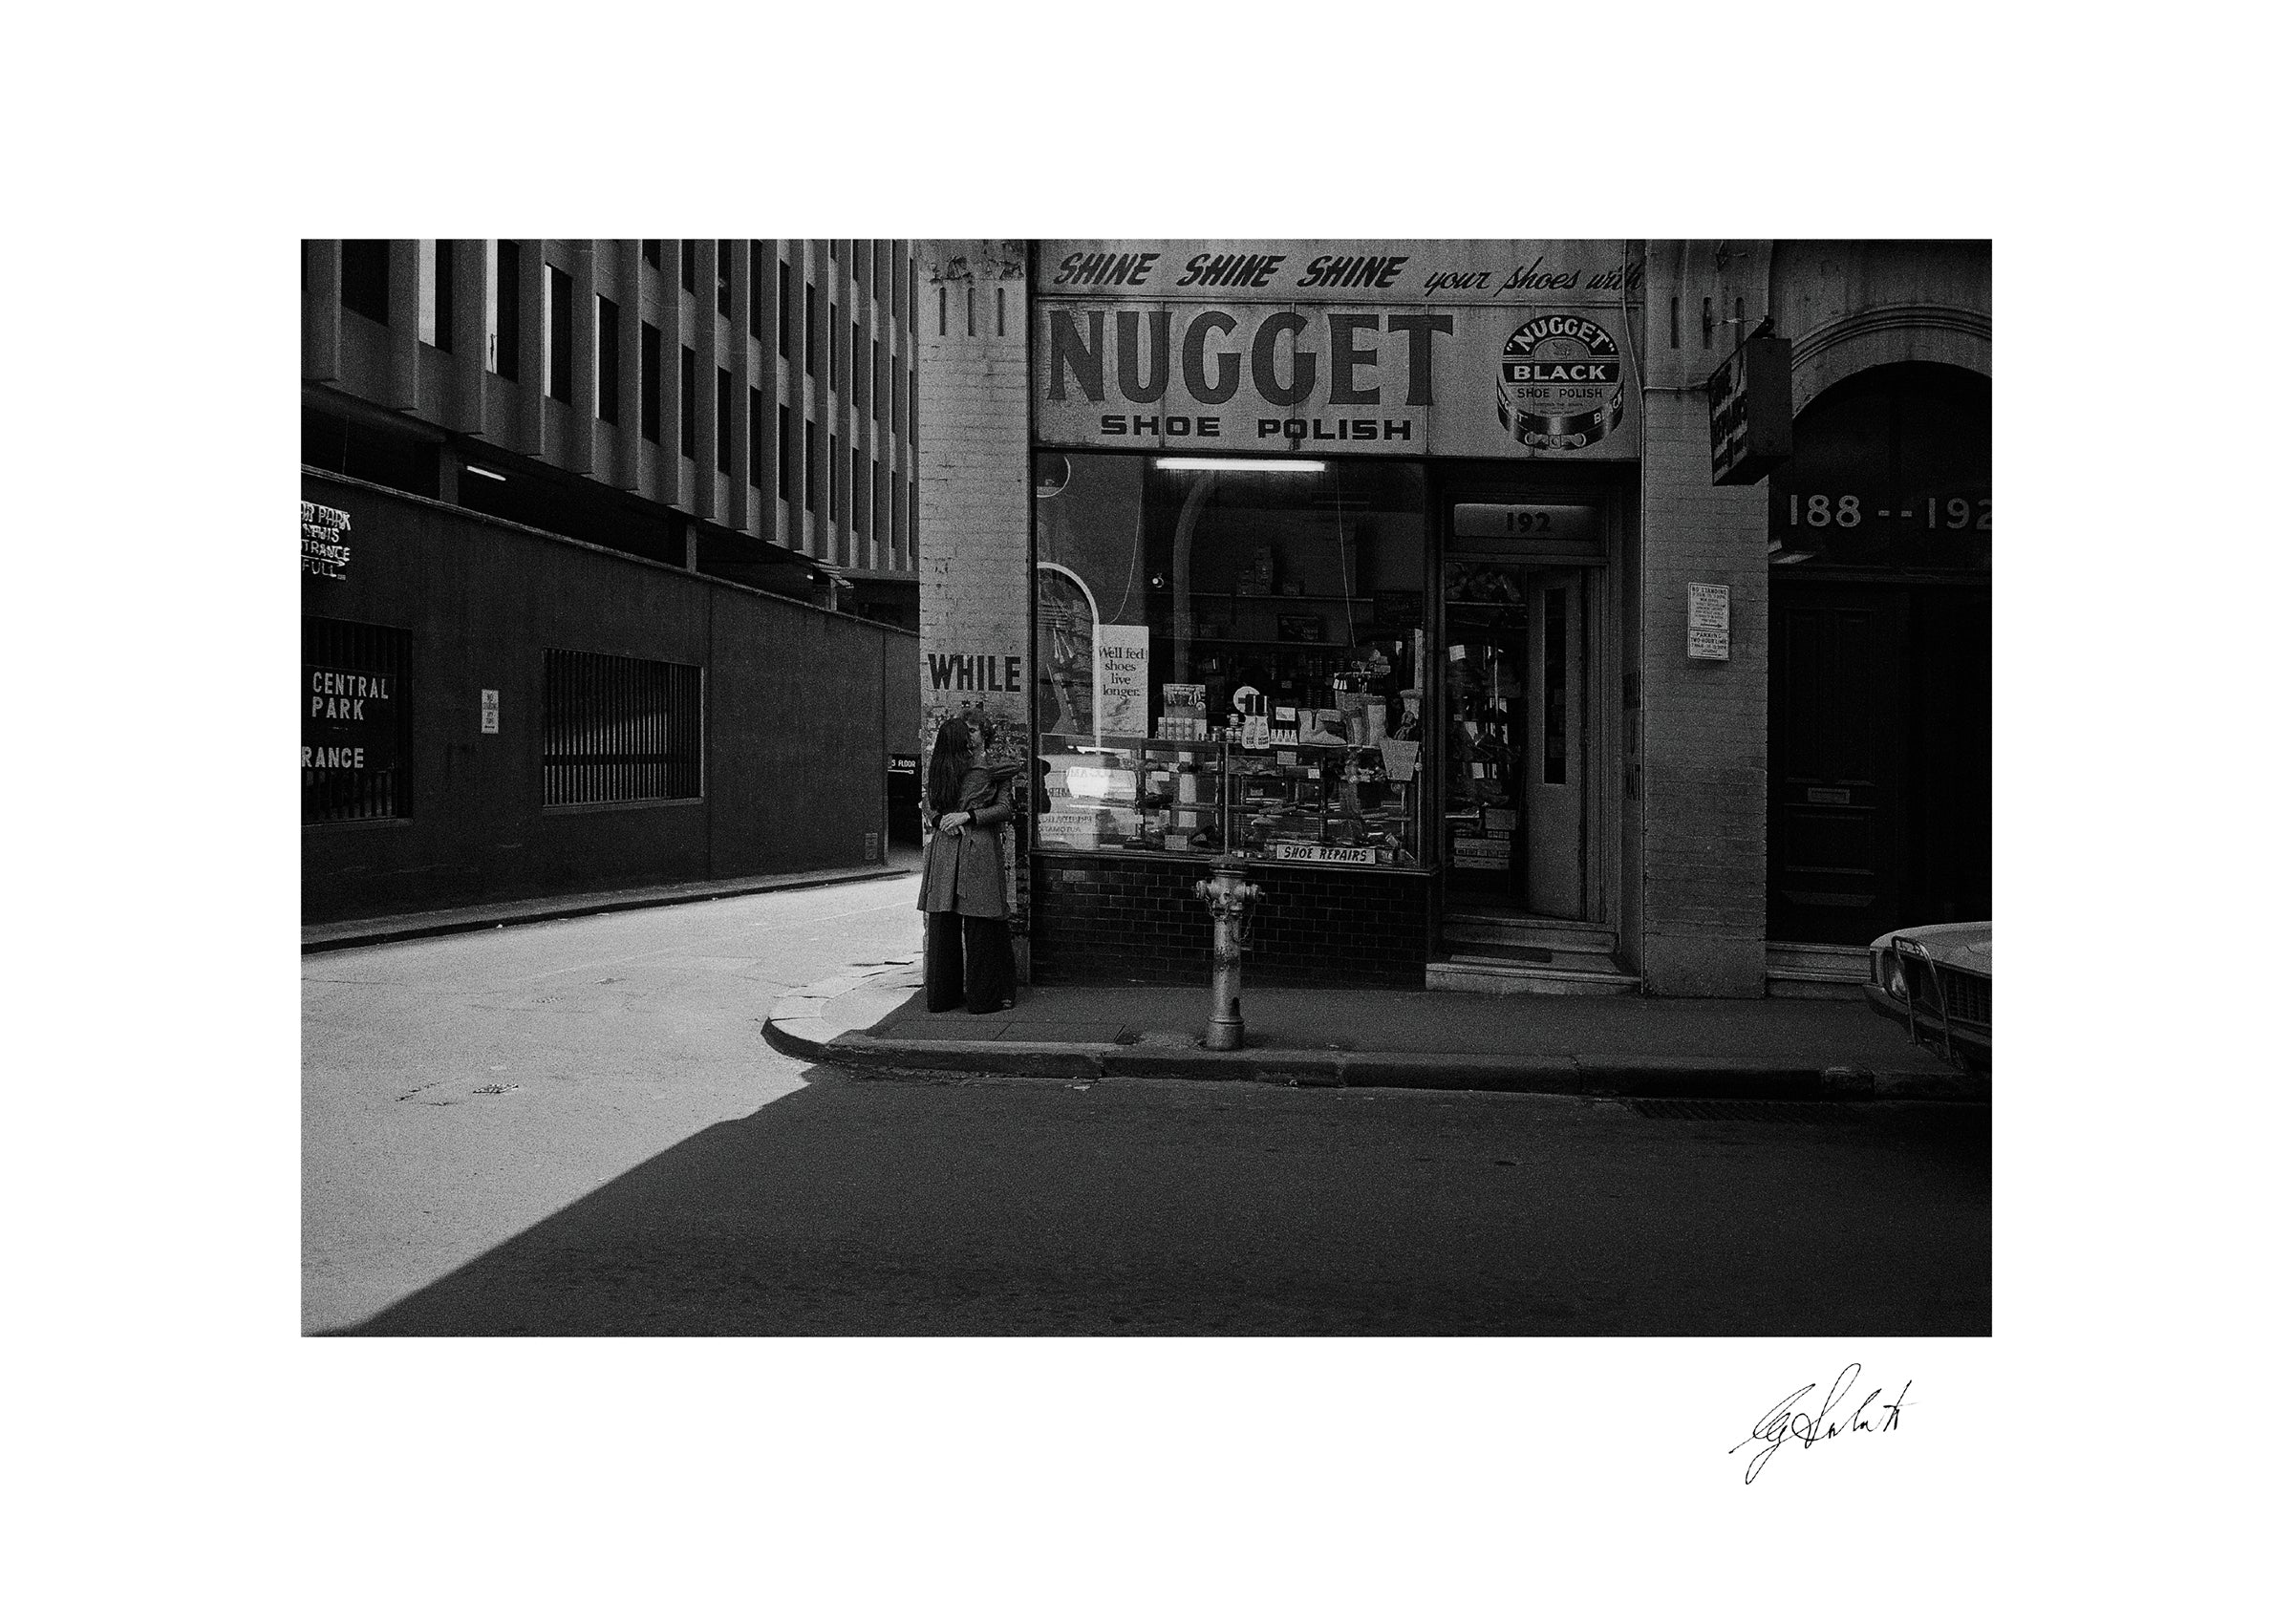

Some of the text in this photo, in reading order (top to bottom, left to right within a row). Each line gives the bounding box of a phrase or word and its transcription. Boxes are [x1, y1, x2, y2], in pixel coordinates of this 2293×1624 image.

[1053, 252, 1161, 286] SHINE
[1176, 253, 1286, 287] SHINE
[1297, 255, 1409, 288] SHINE
[1424, 271, 1491, 298] your
[1493, 256, 1582, 298] shoes
[1045, 310, 1453, 406] NUGGET
[1513, 365, 1606, 380] BLACK
[1517, 388, 1603, 398] SHOE POLISH
[1101, 415, 1412, 441] SHOE POLISH
[318, 505, 352, 531] PARK
[1507, 512, 1552, 533] 192
[1789, 494, 1862, 528] 188
[301, 539, 351, 562] TRANCE
[1099, 646, 1145, 660] Well fed
[927, 653, 1021, 693] WHILE
[1104, 659, 1137, 672] shoes
[312, 672, 389, 700] CENTRAL
[1111, 673, 1131, 685] live
[1103, 684, 1140, 700] longer.
[311, 696, 365, 721] PARK
[301, 746, 364, 769] RANCE
[1284, 845, 1367, 862] SHOE REPAIRS
